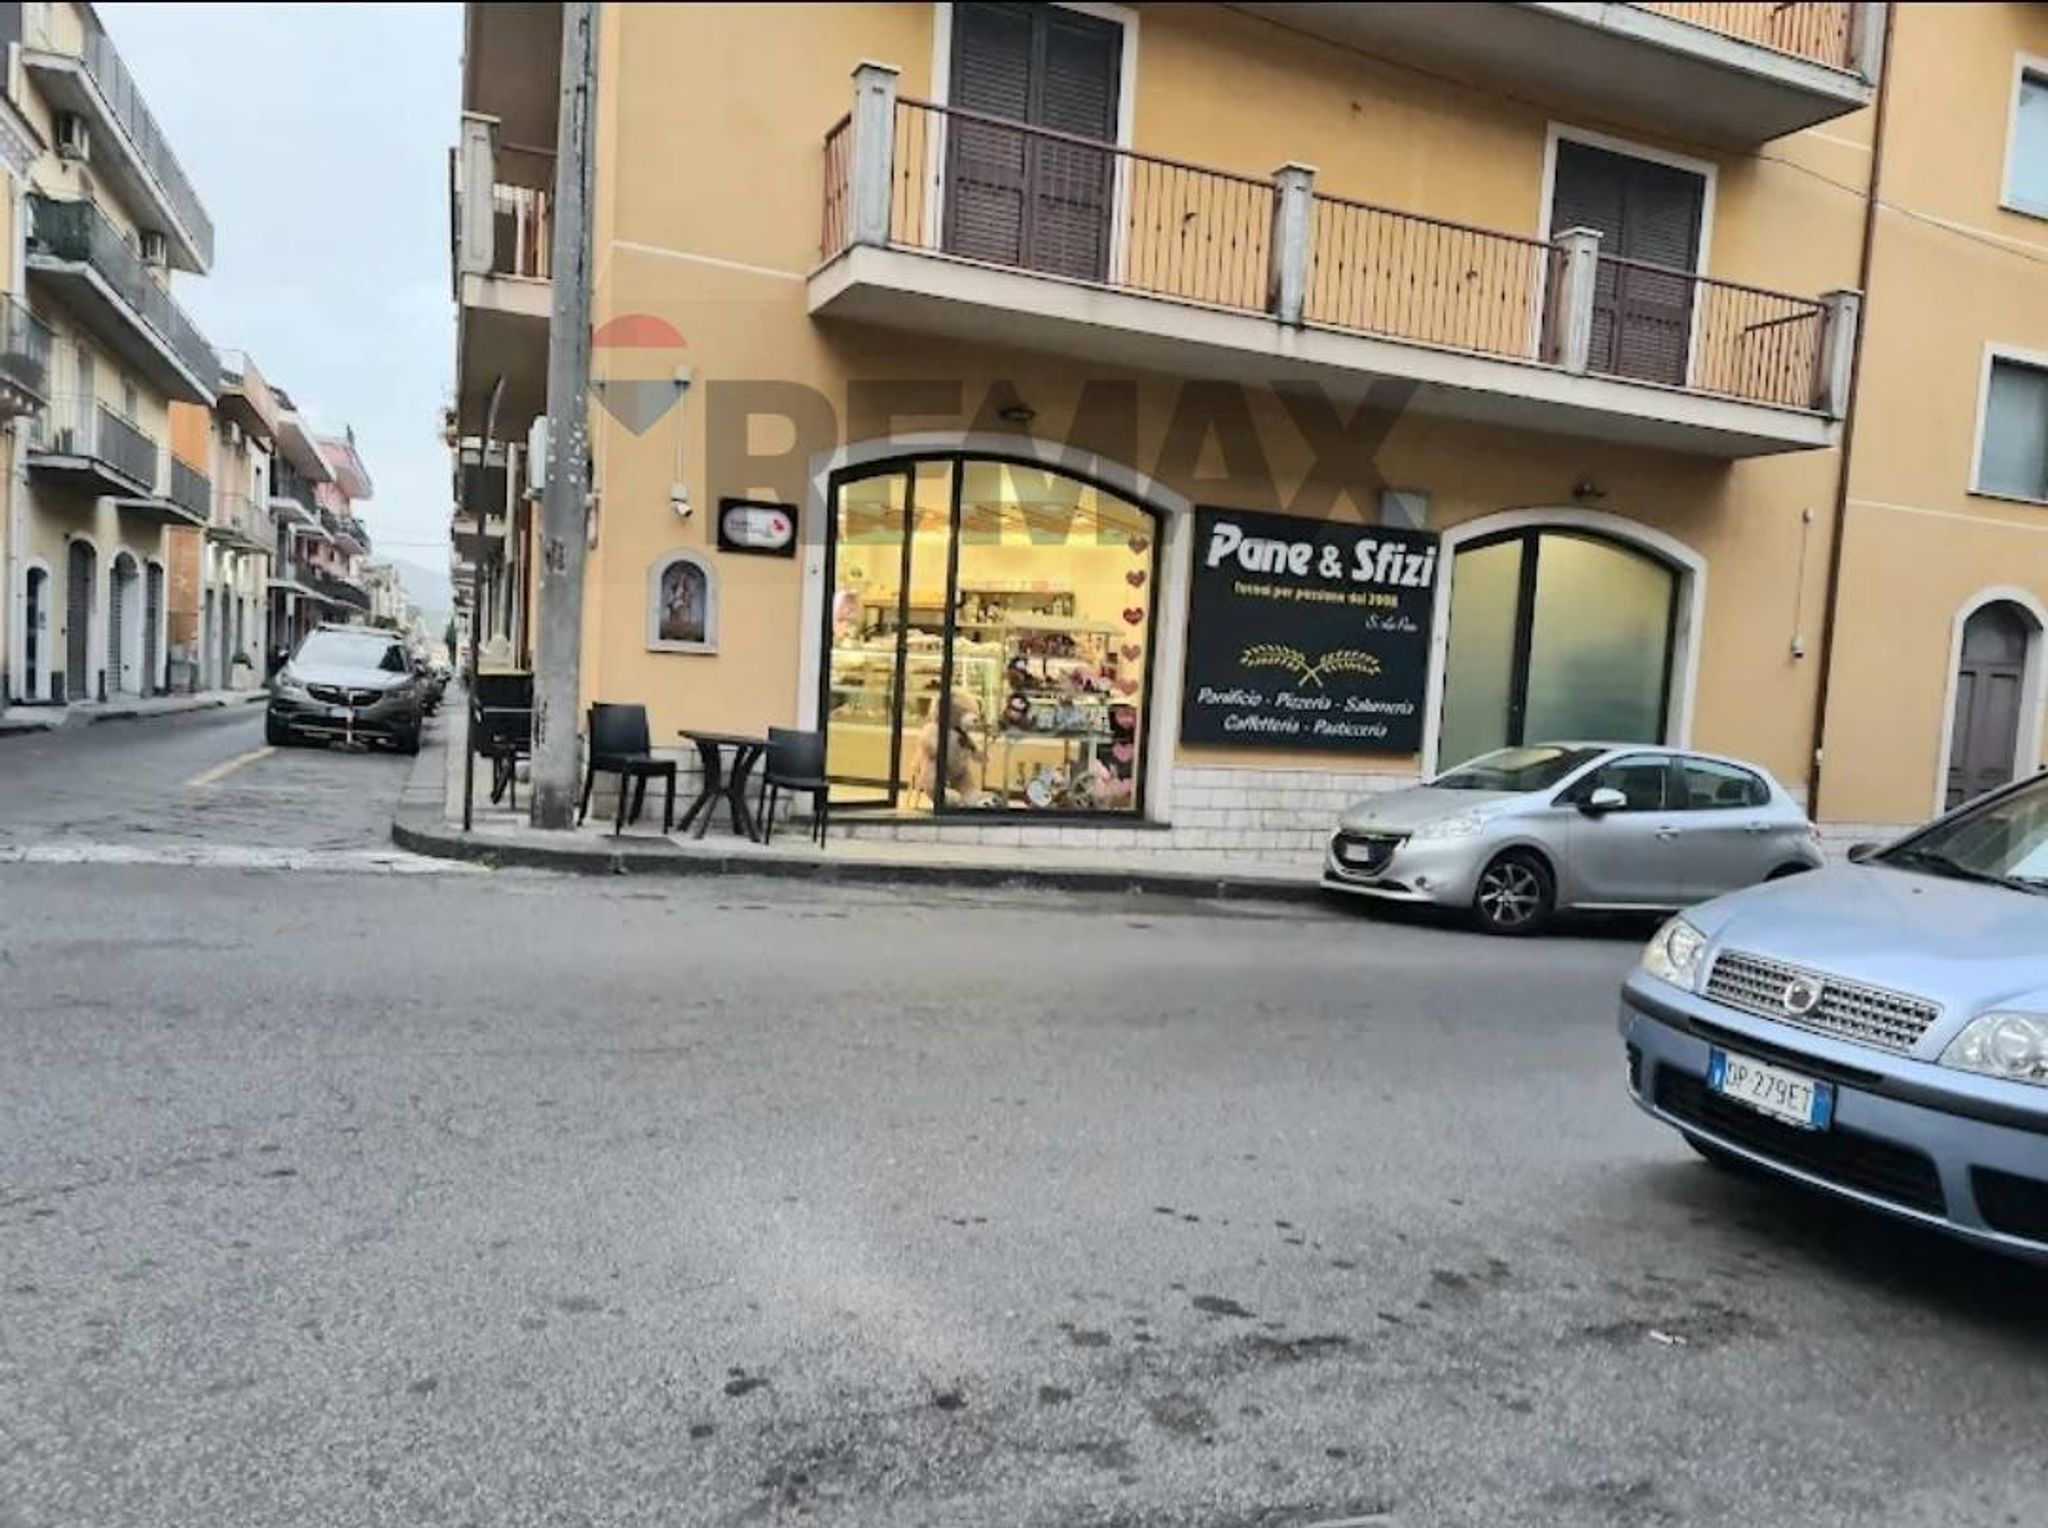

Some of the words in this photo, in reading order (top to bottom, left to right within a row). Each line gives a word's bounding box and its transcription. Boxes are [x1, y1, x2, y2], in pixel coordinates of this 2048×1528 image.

[1206, 522, 1313, 576] Pane
[1318, 545, 1342, 578] &
[1352, 539, 1436, 587] Sfizi
[1198, 686, 1262, 707] Panificio
[1275, 691, 1332, 711] Pizzeria
[1344, 696, 1414, 715] Salumeria
[1223, 713, 1300, 733] Caffetteria
[1313, 718, 1388, 738] Pasticceria
